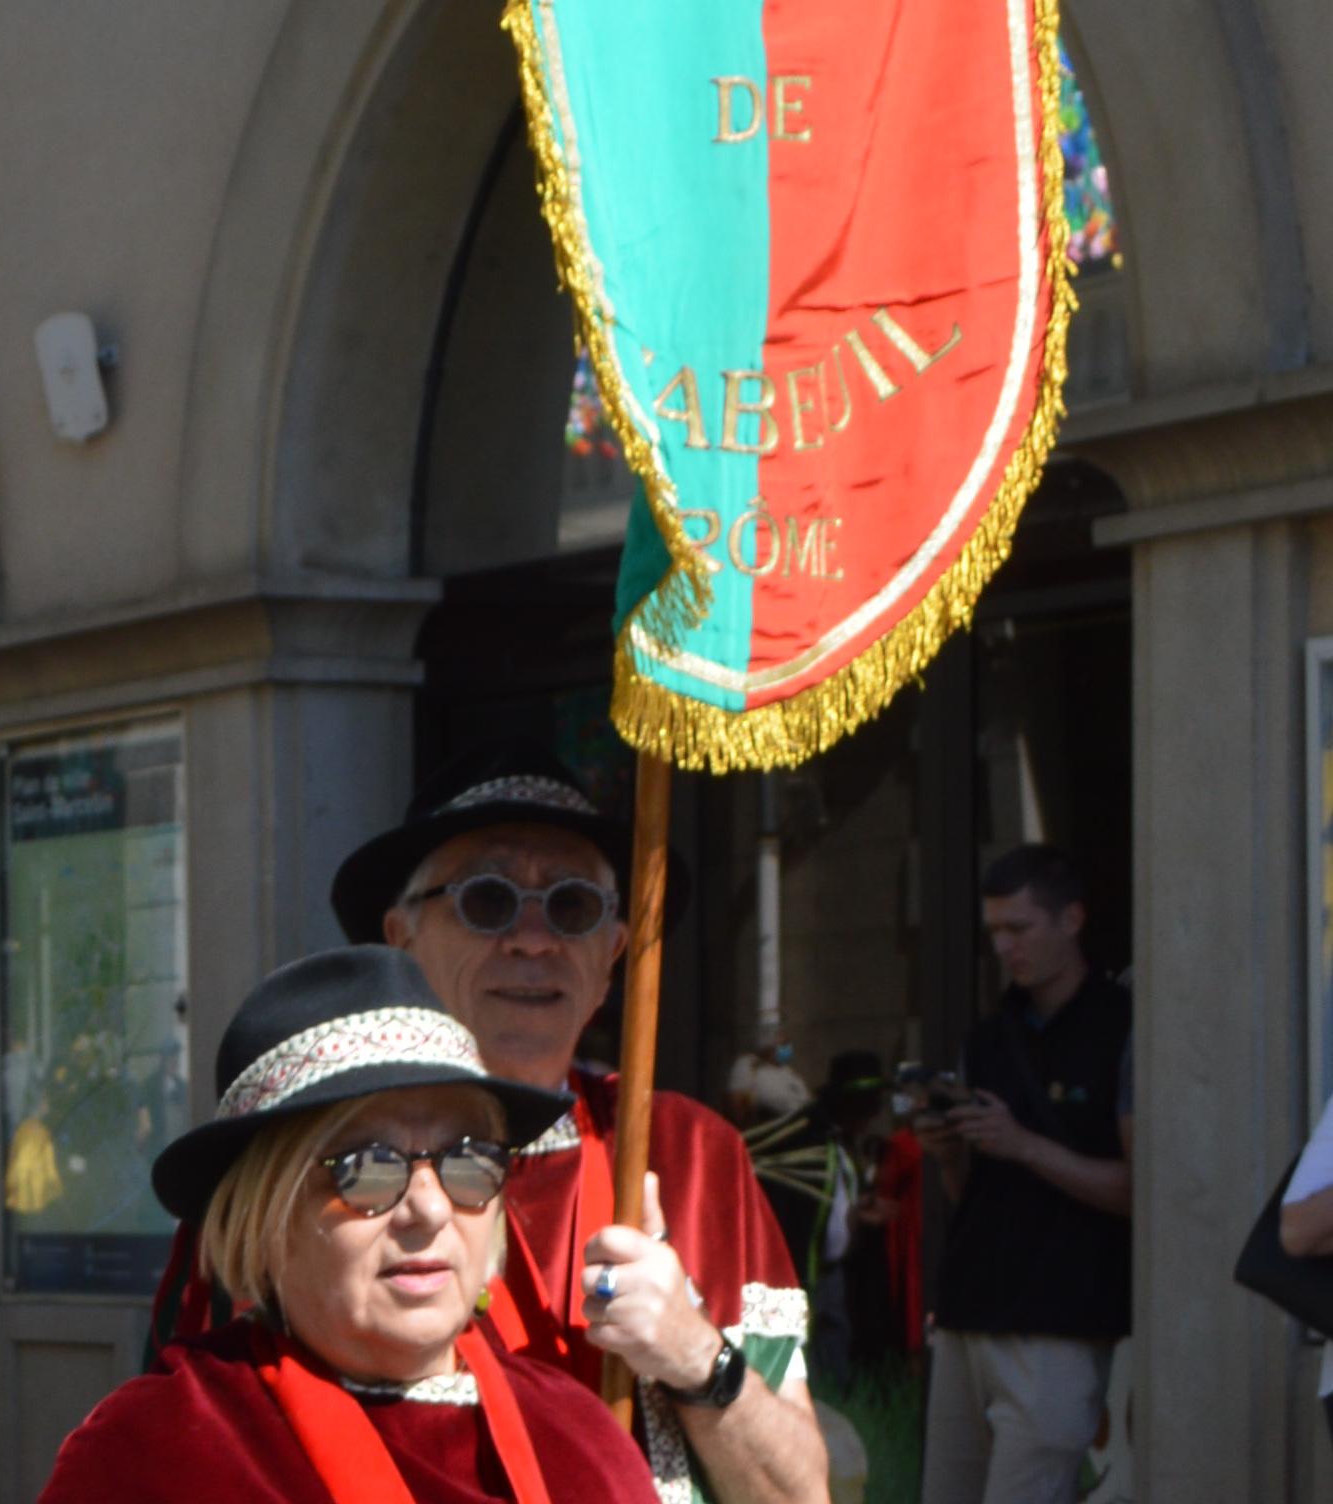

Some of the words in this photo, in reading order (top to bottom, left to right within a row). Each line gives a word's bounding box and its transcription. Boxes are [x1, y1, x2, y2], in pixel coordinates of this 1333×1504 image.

[709, 74, 813, 145] DE
[640, 303, 963, 457] ABEUIL
[673, 496, 844, 582] RÔME
